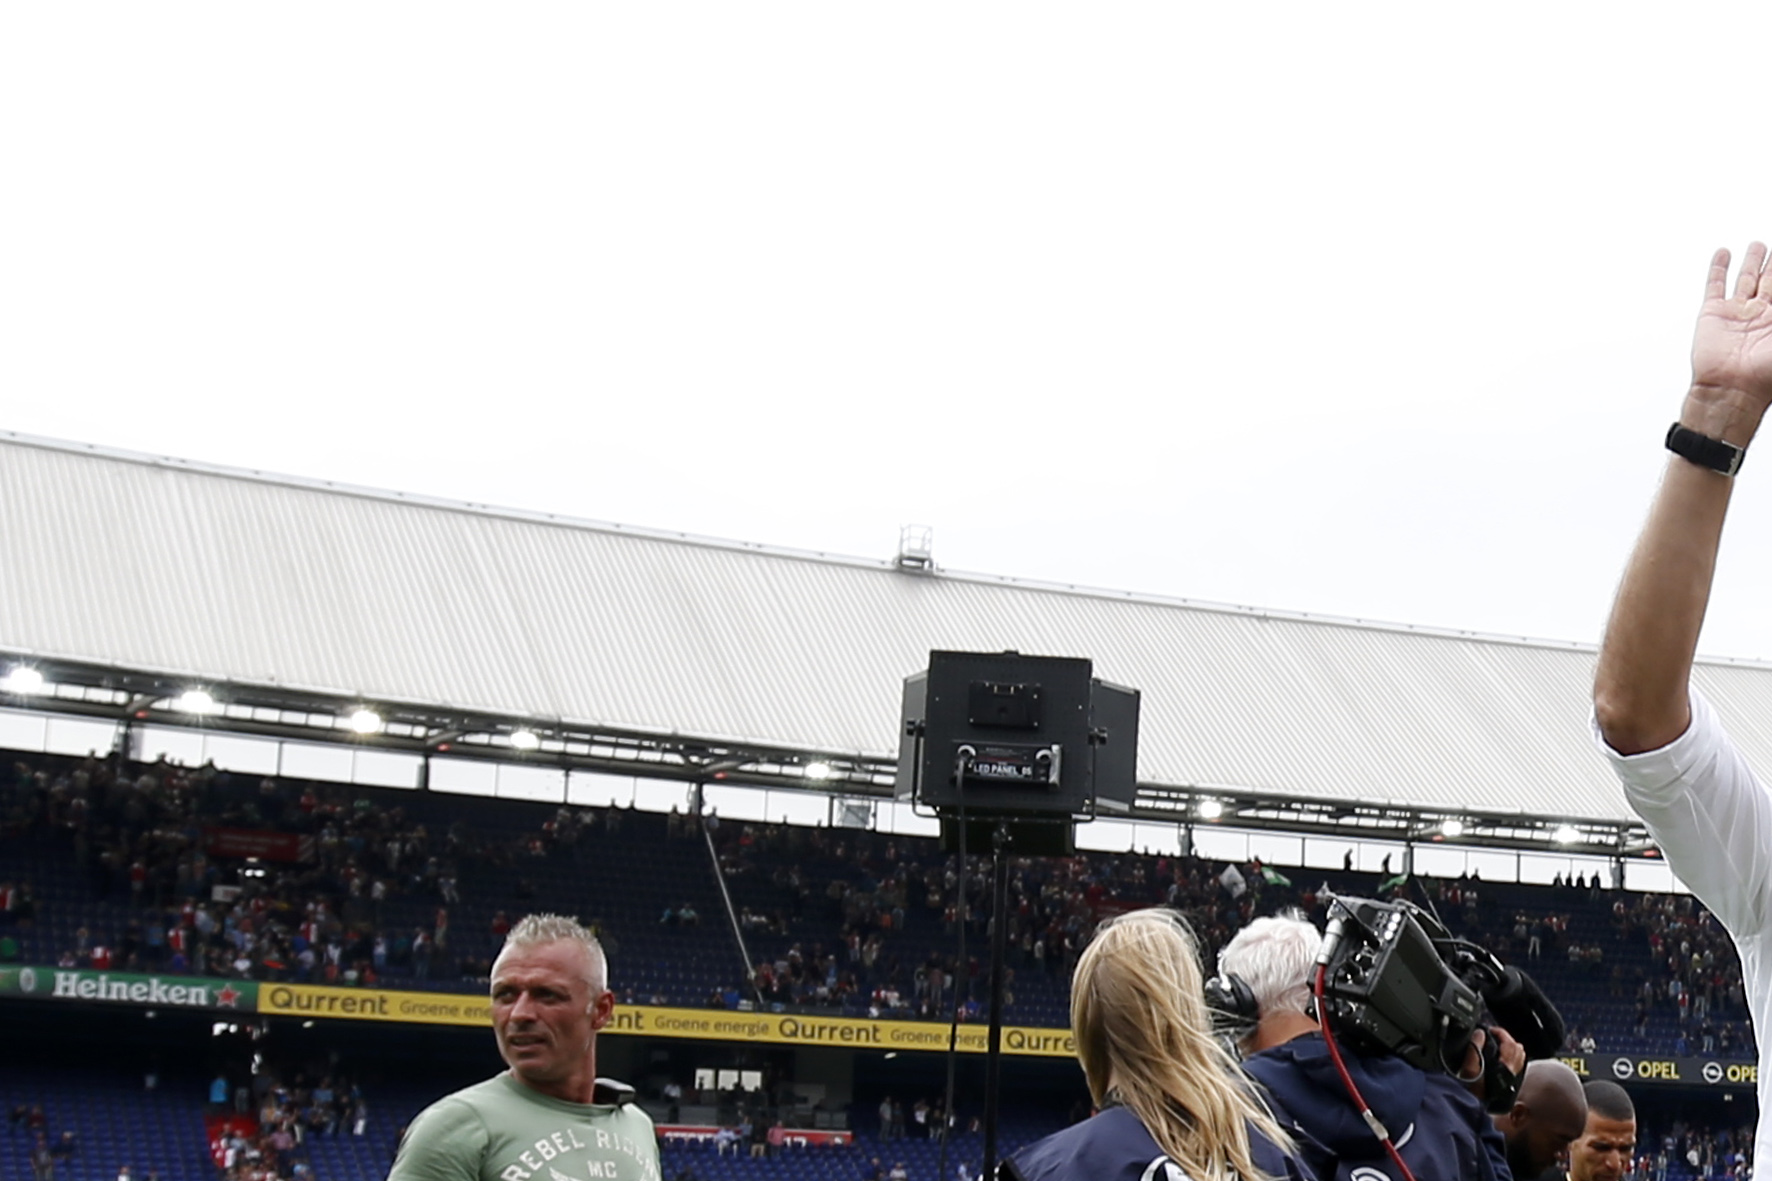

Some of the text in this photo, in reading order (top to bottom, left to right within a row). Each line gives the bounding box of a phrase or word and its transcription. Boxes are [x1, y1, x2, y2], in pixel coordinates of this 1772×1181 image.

[973, 763, 990, 773] LED
[52, 971, 209, 1006] Heineken
[270, 986, 388, 1014] Qurrent
[399, 999, 458, 1018] Groene
[654, 1015, 710, 1032] Groene
[713, 1020, 770, 1036] energie
[778, 1017, 881, 1041] Qurrent
[889, 1029, 942, 1043] Groene
[1638, 1060, 1680, 1080] OPEL
[587, 1160, 617, 1179] MC
